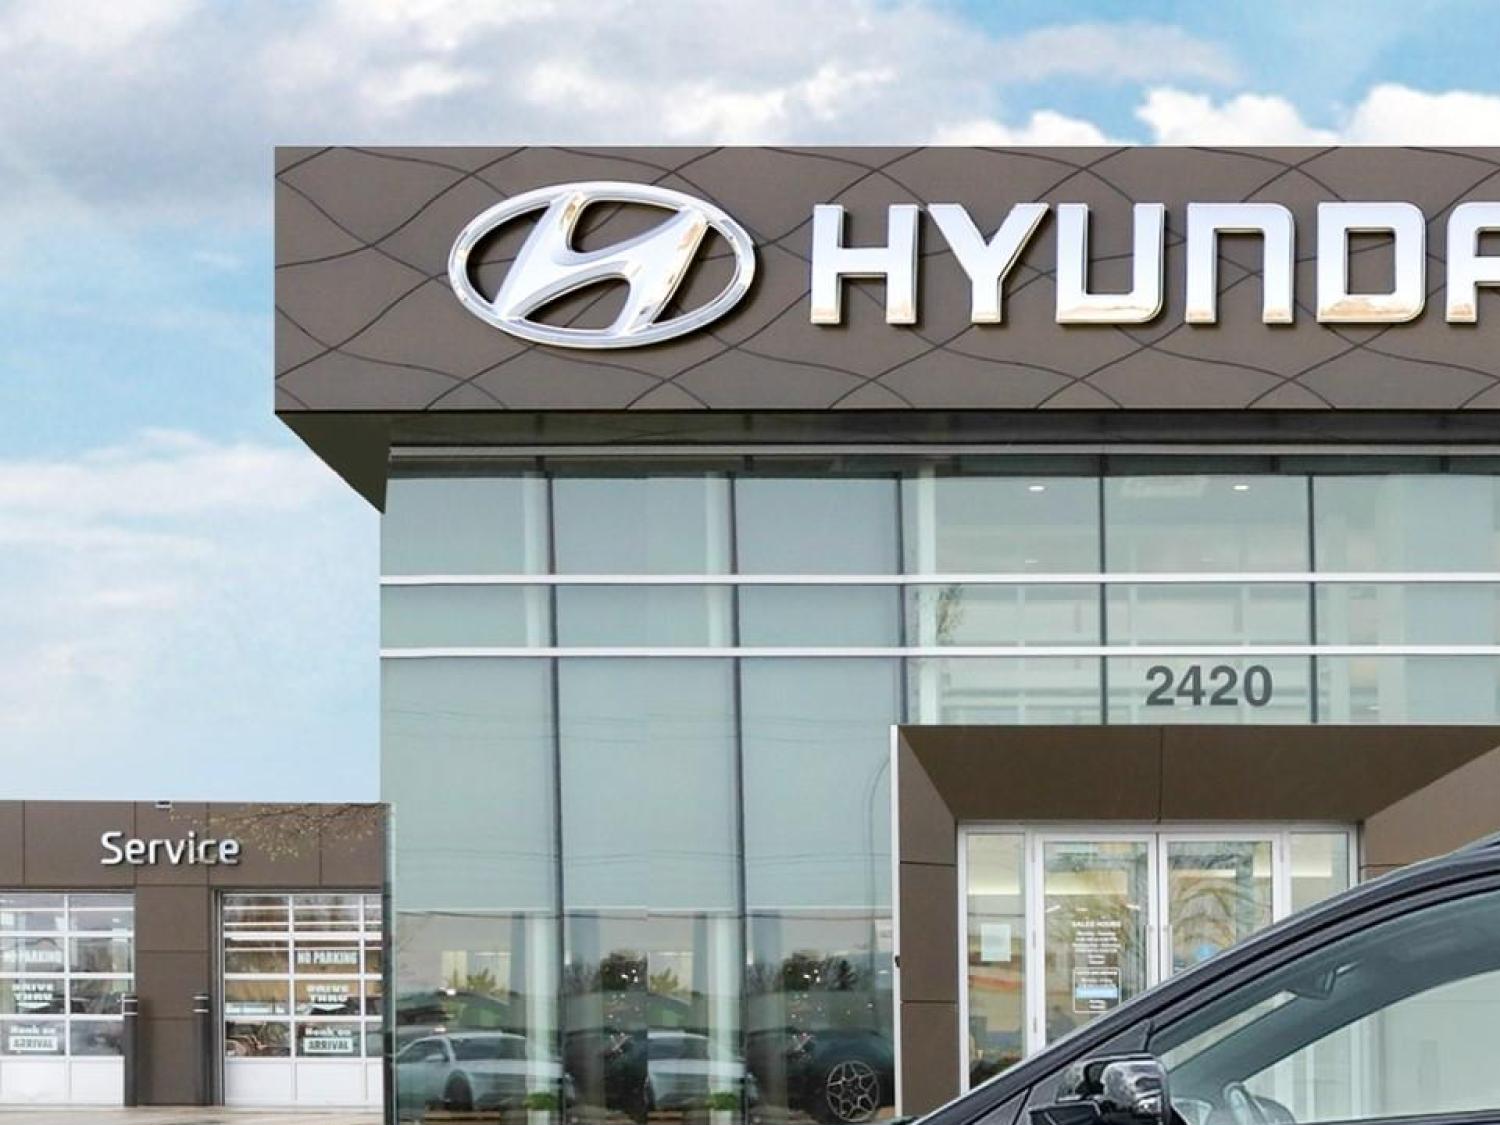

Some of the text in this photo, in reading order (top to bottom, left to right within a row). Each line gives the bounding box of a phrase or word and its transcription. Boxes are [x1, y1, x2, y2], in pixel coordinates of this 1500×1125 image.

[1145, 665, 1273, 707] 2420
[100, 831, 239, 865] Service
[308, 1040, 349, 1050] ARRIVAL
